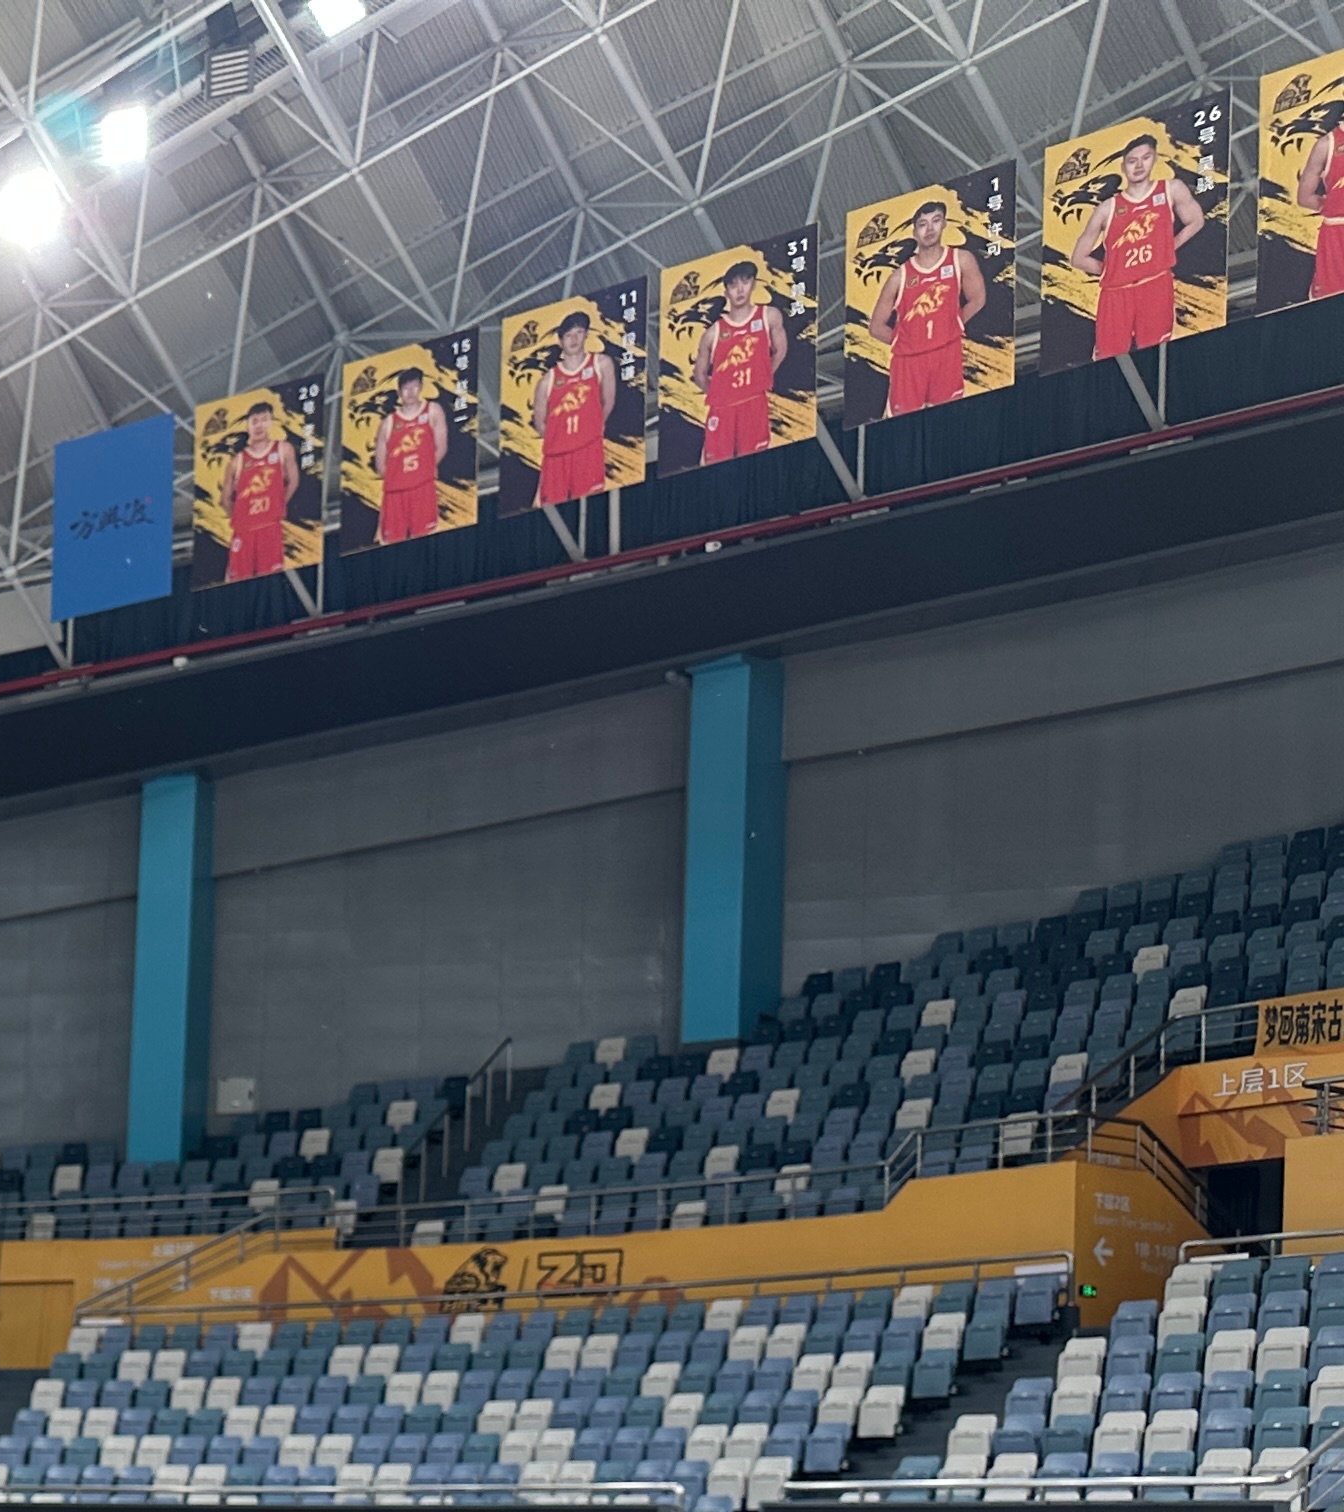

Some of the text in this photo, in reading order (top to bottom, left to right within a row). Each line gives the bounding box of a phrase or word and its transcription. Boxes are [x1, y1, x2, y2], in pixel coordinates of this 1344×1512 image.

[1125, 244, 1152, 268] 26
[926, 319, 933, 339] 1
[732, 367, 752, 388] 31
[1214, 1062, 1308, 1098] 上层1区
